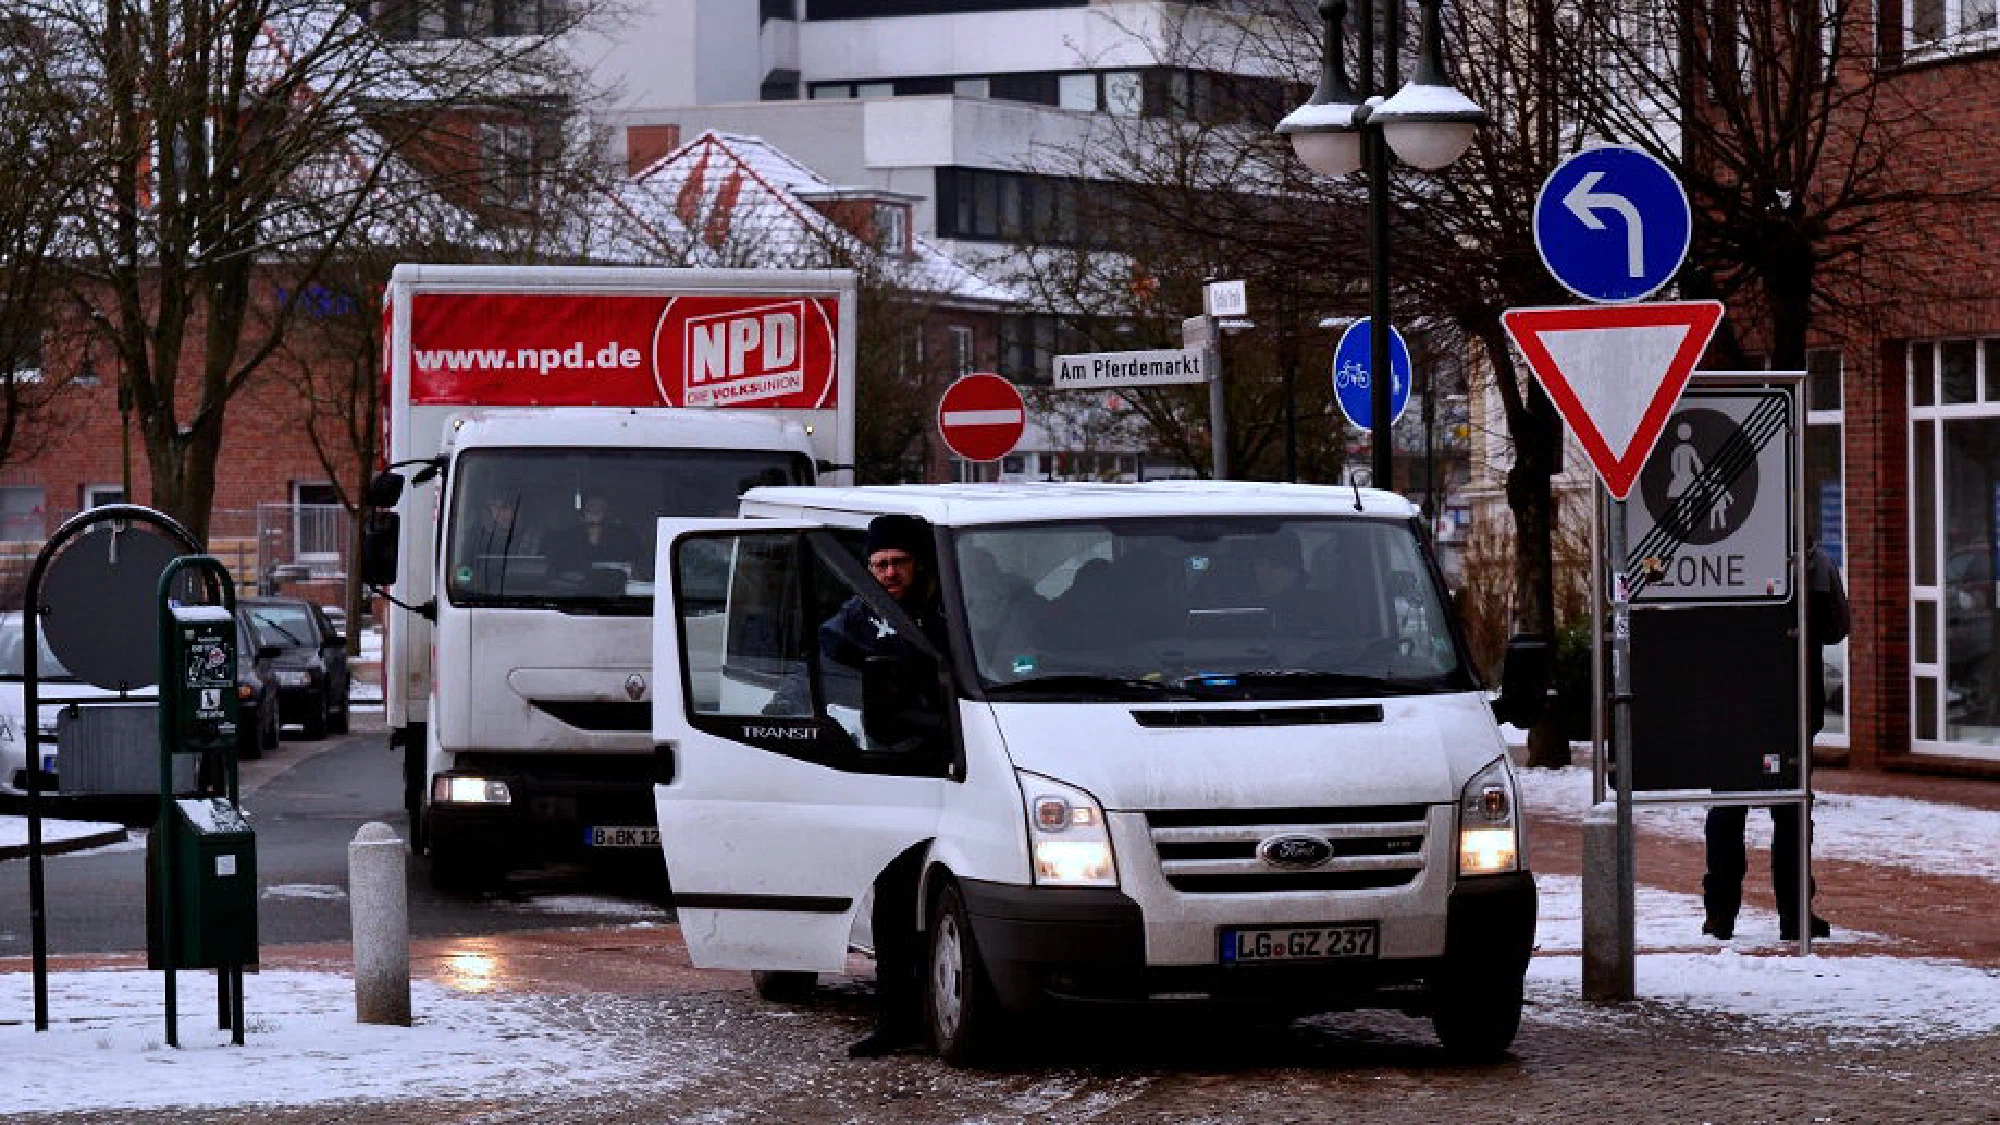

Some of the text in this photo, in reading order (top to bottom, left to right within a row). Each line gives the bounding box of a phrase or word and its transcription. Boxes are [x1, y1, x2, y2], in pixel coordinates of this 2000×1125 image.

[413, 341, 642, 376] www.npd.de
[692, 313, 797, 383] NPD
[1060, 354, 1200, 380] Am Pferdemarkt
[688, 375, 801, 403] DIE VOLKSUNION
[1649, 554, 1745, 587] ZONE
[742, 725, 820, 740] TRANSIT
[1237, 928, 1373, 958] LG GZ 237
